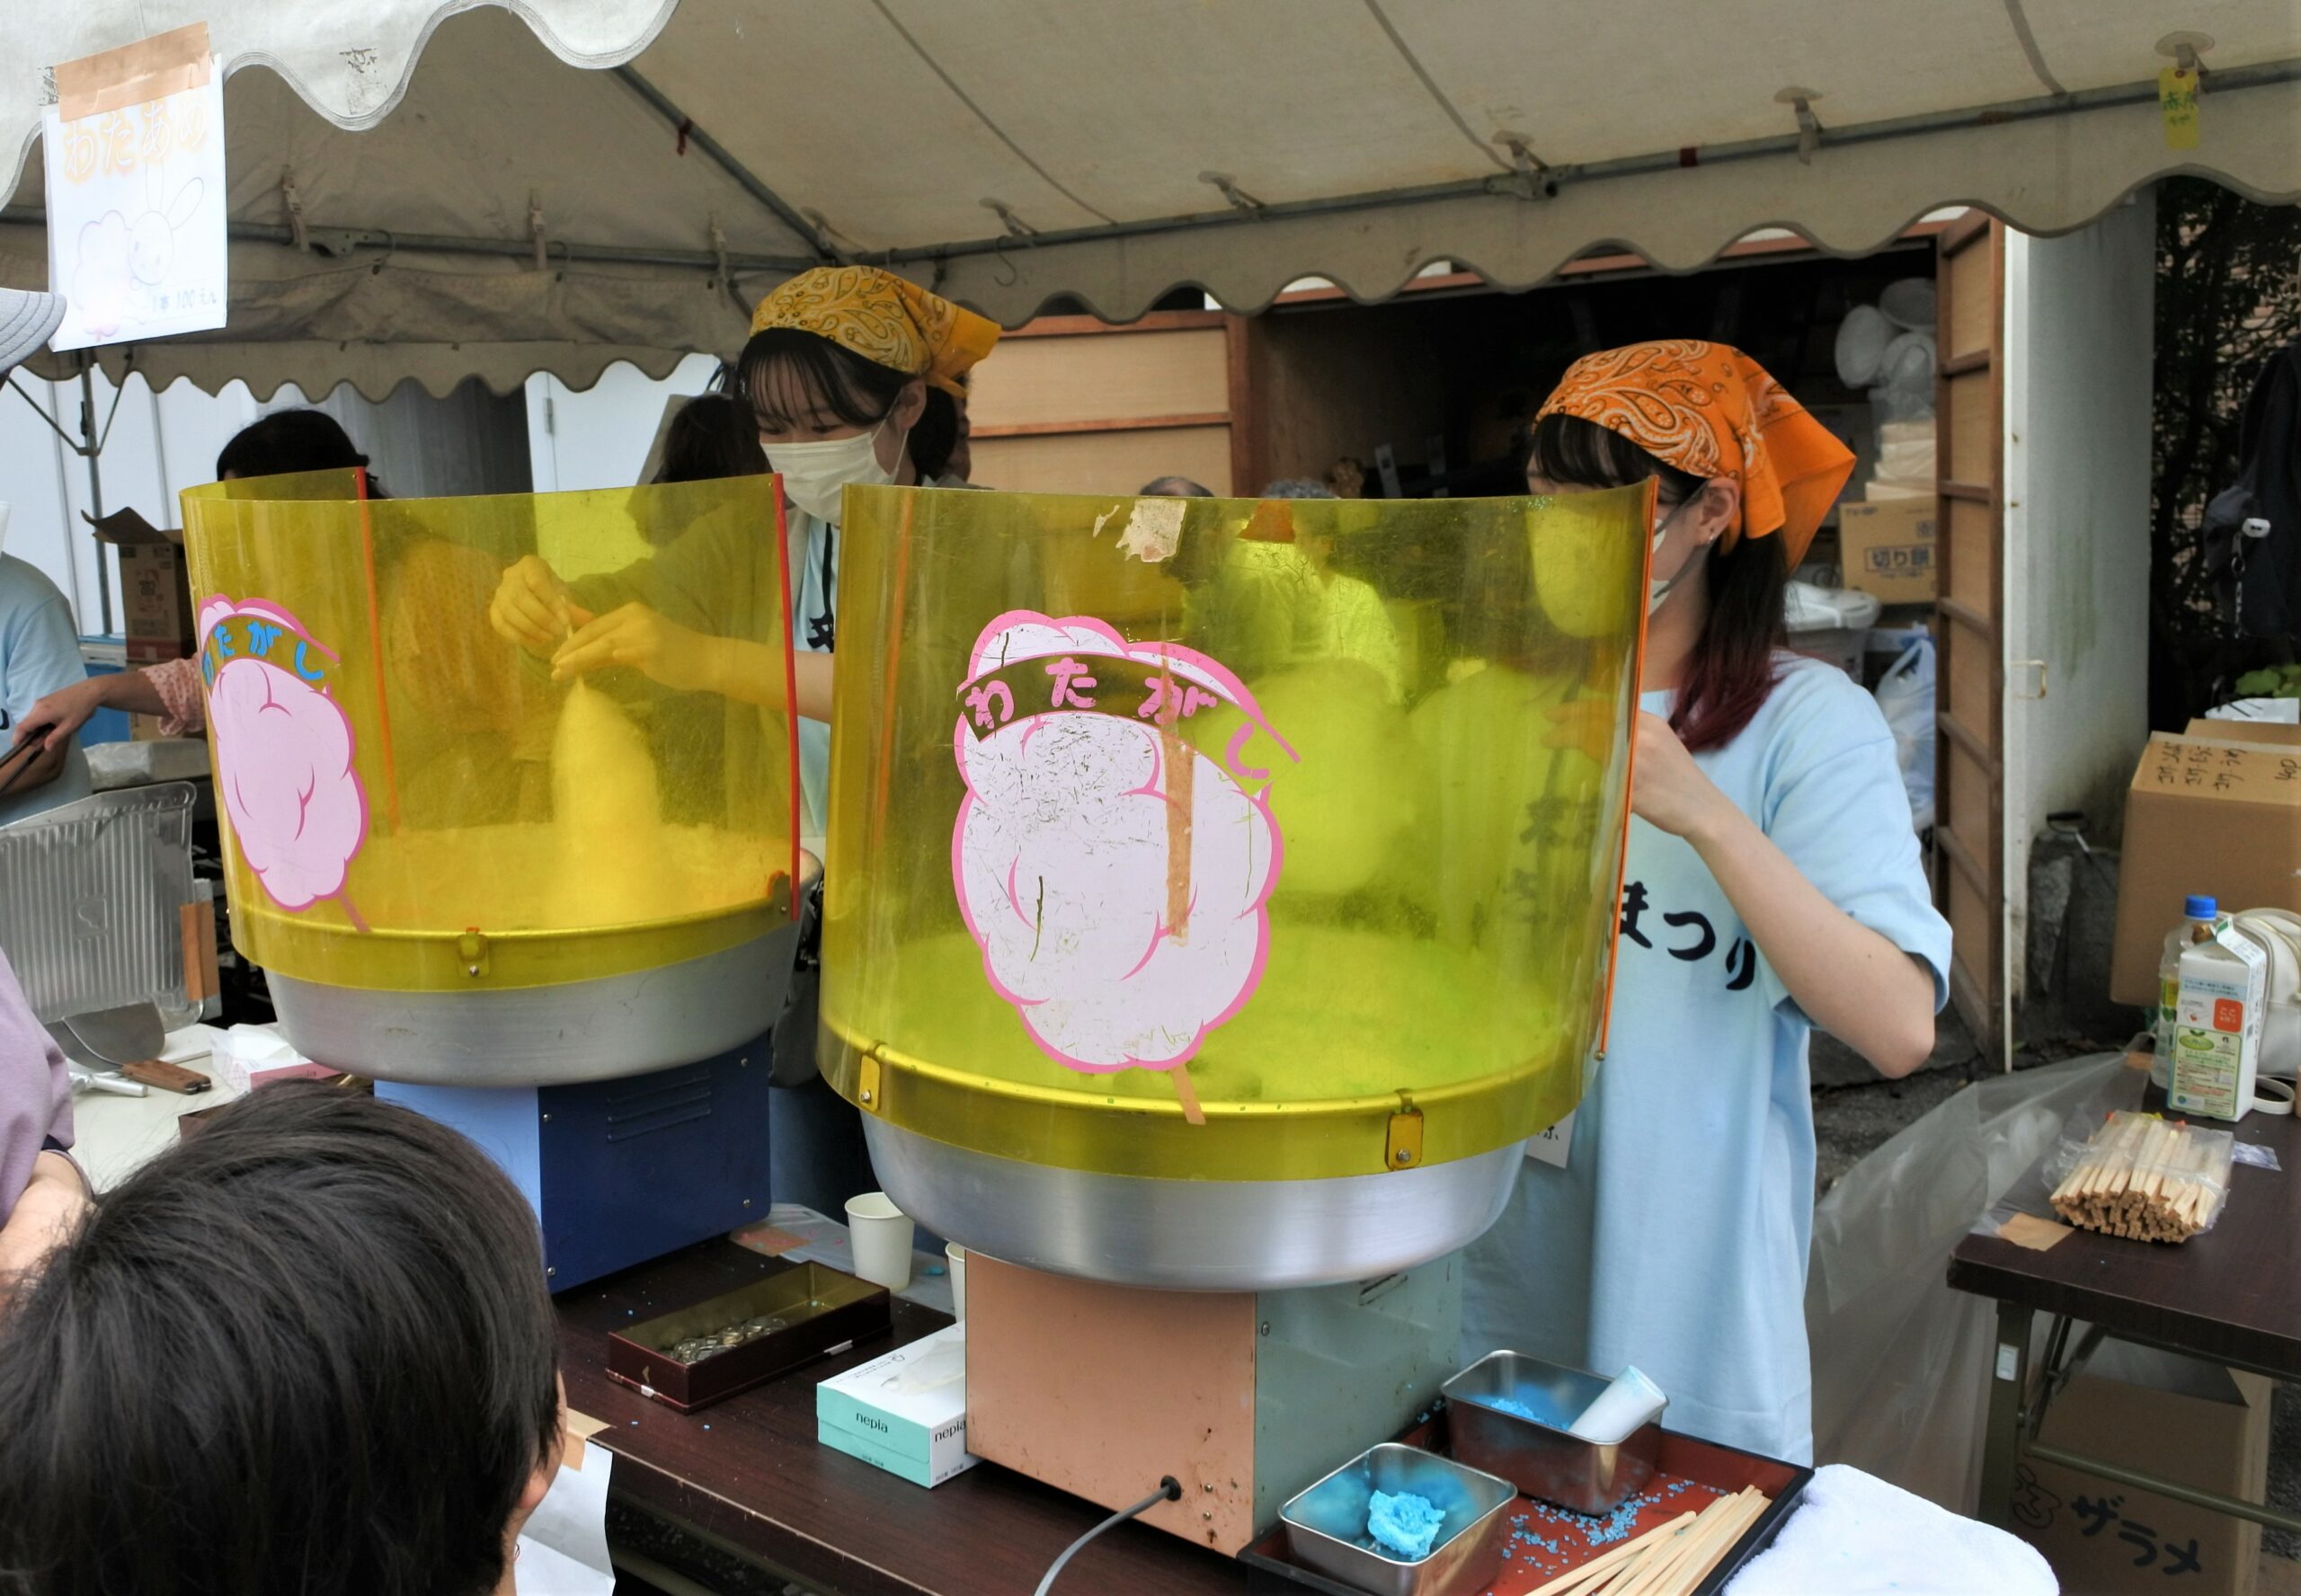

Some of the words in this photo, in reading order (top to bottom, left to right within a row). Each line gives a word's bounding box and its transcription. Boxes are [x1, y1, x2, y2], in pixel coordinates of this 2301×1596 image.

[66, 98, 209, 178] わたあめ
[964, 657, 1270, 780] わたがし
[856, 1412, 888, 1433] nepia
[935, 1419, 965, 1442] nepia
[2071, 1495, 2202, 1575] ザラメ
